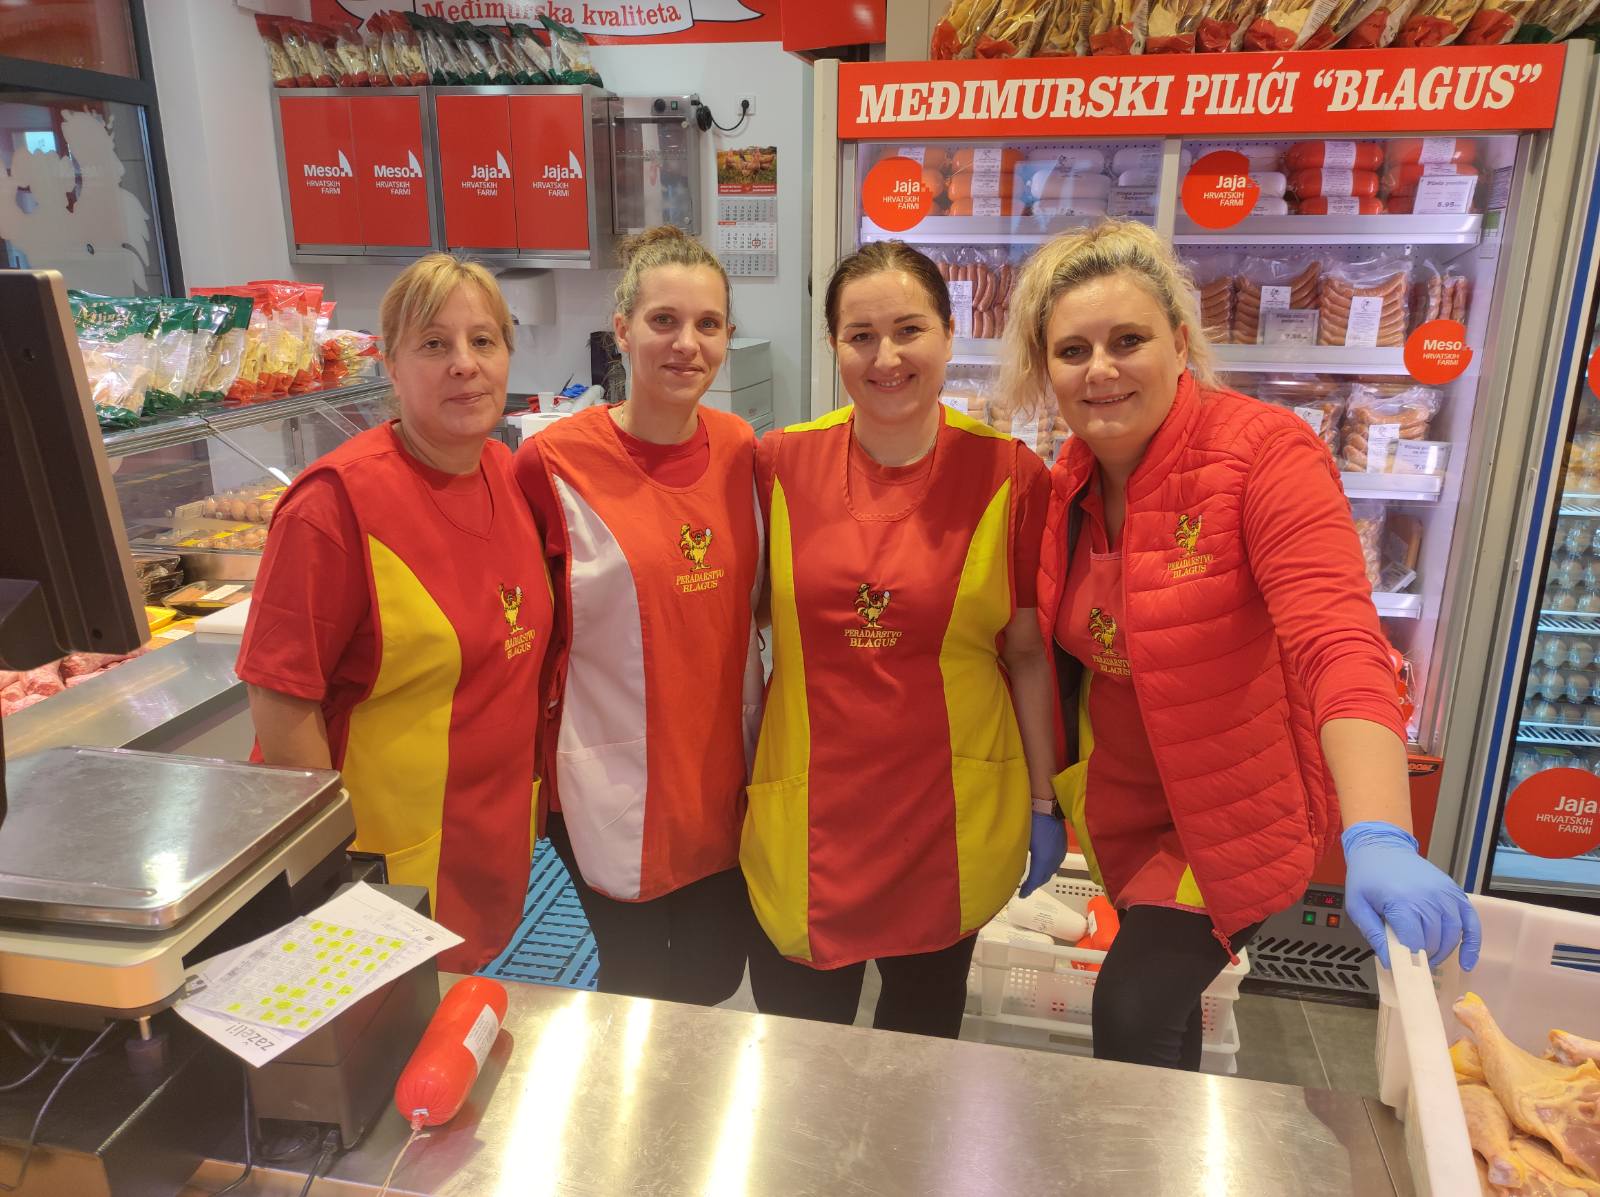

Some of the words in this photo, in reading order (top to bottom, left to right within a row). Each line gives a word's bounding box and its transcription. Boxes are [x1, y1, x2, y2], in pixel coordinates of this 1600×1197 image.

[582, 4, 682, 27] kvaliteta
[856, 74, 1175, 124] MEĐIMURSKI
[1180, 56, 1301, 116] PILIĆI
[303, 164, 340, 177] Meso
[374, 165, 410, 178] Meso
[471, 164, 498, 181] Jaja
[542, 164, 569, 181] Jaja
[461, 181, 498, 189] HRVATSKIH
[532, 181, 569, 189] HRVATSKIH
[892, 179, 921, 196] Jaja
[1215, 174, 1247, 191] Jaja
[321, 187, 341, 195] FARMI
[391, 188, 411, 196] FARMI
[477, 188, 498, 197] FARMI
[548, 189, 570, 197] FARMI
[1203, 191, 1245, 199] HRVATSKIH
[882, 195, 921, 203] HRVATSKIH
[1219, 199, 1245, 207] FARMI
[898, 202, 920, 210] FARMI
[1423, 339, 1462, 351] Meso
[1422, 352, 1460, 360] HRVATSKIH
[1173, 564, 1207, 579] BLAGUS
[682, 580, 719, 593] BLAGUS
[844, 628, 902, 638] PERADARSTVO
[849, 637, 897, 648] BLAGUS
[1554, 796, 1598, 816] Jaja
[1536, 813, 1594, 826] HRVATSKIH
[1558, 824, 1592, 835] FARMI
